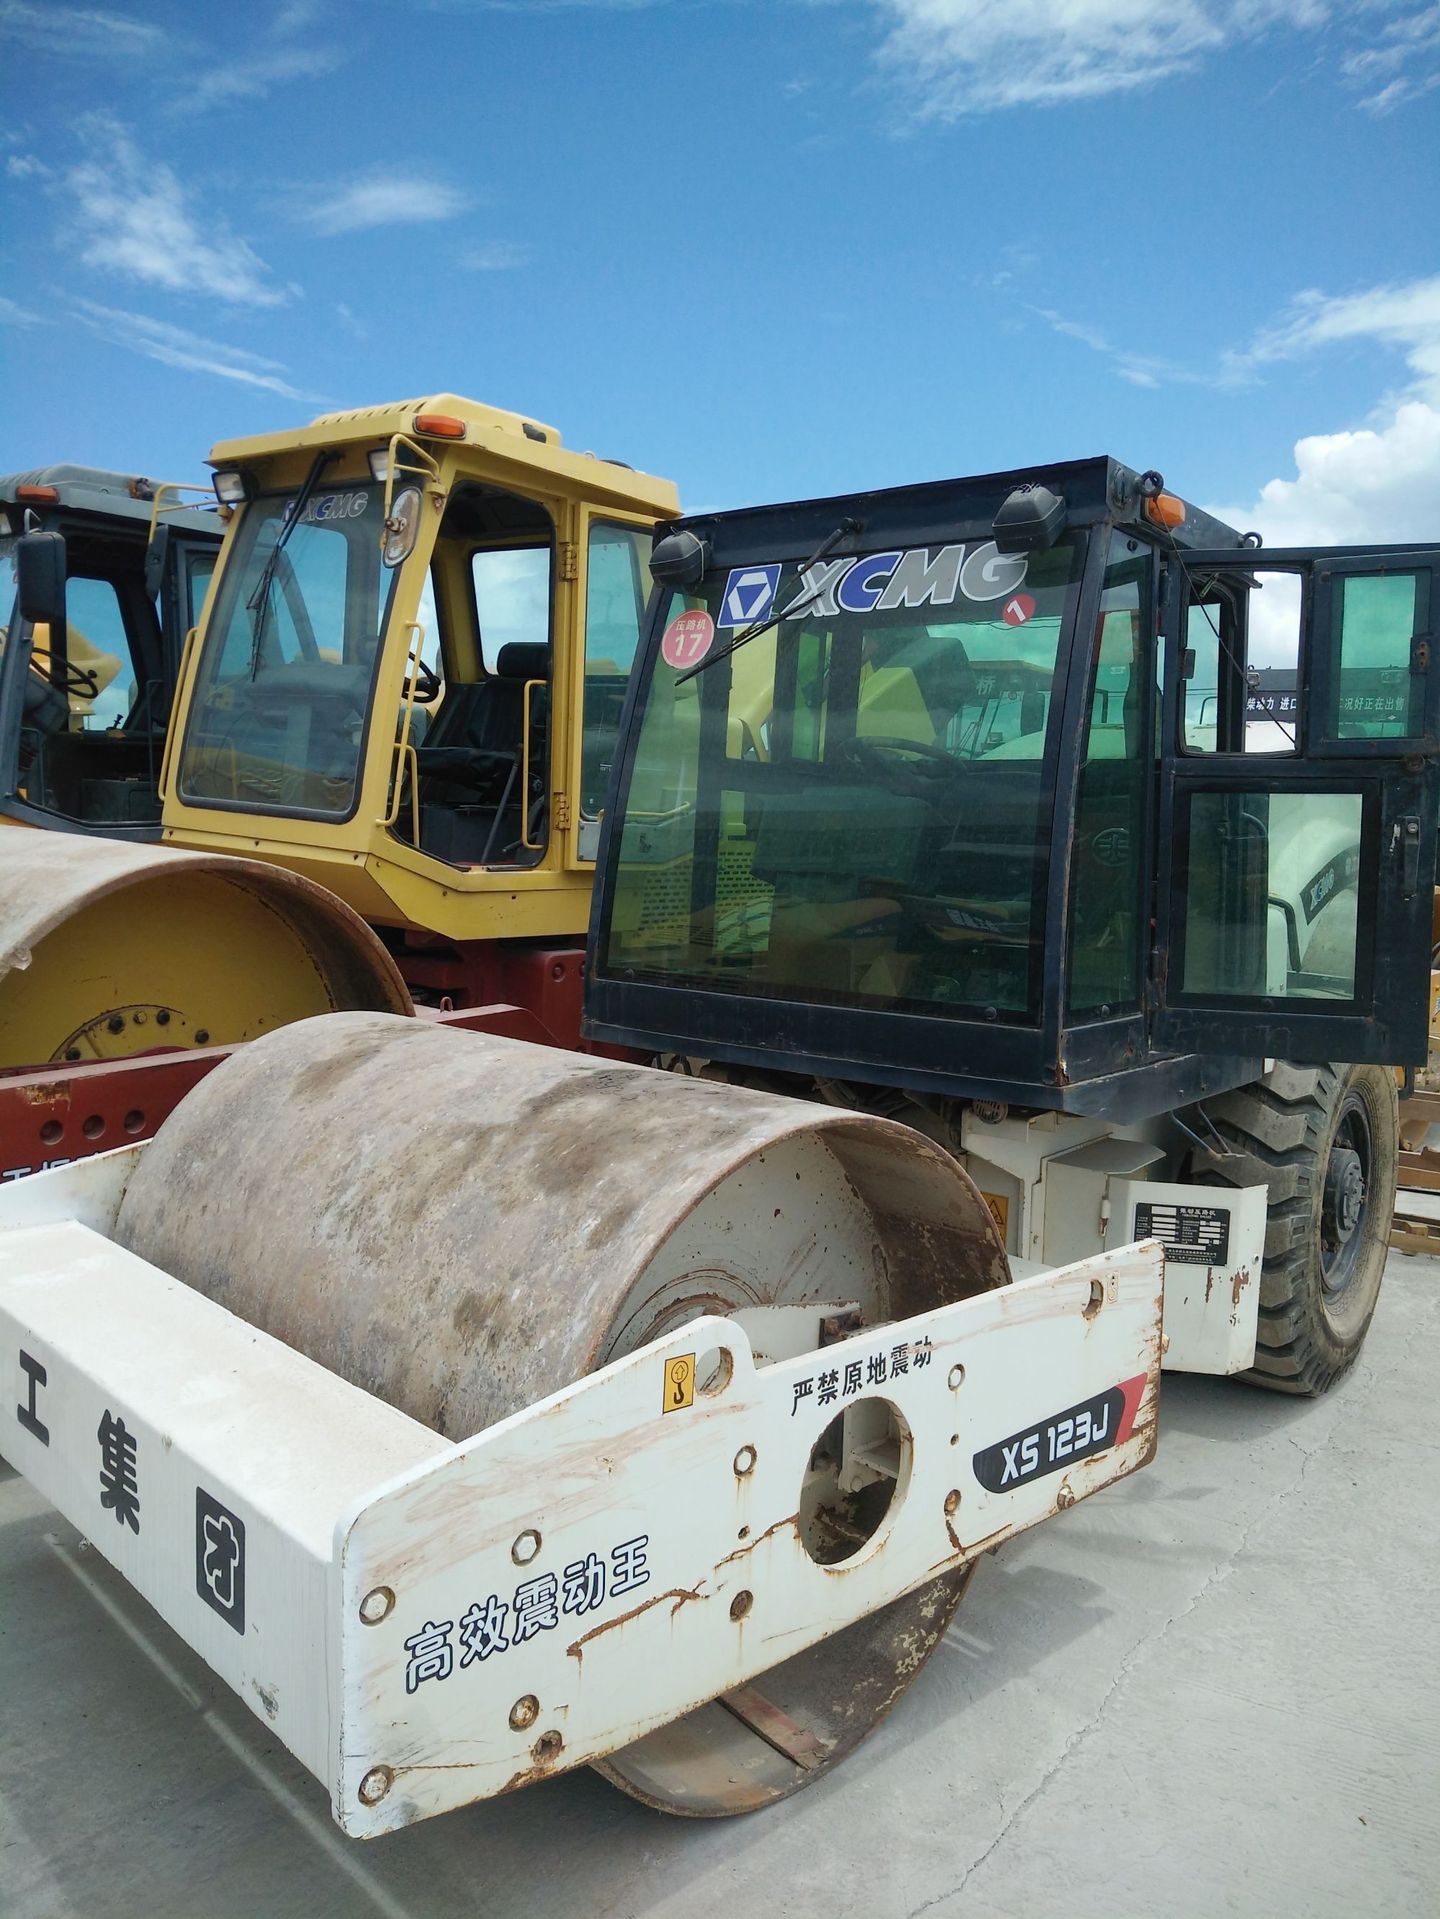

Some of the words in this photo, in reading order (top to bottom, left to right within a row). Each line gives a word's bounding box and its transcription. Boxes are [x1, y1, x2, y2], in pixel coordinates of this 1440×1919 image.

[300, 493, 368, 521] XCMG
[780, 541, 1028, 620] XCMG
[675, 633, 703, 657] 17
[790, 1335, 933, 1417] 严禁原地震动
[1000, 1441, 1039, 1485] XS
[1047, 1402, 1109, 1463] 123J
[404, 1534, 650, 1694] 高效震动王
